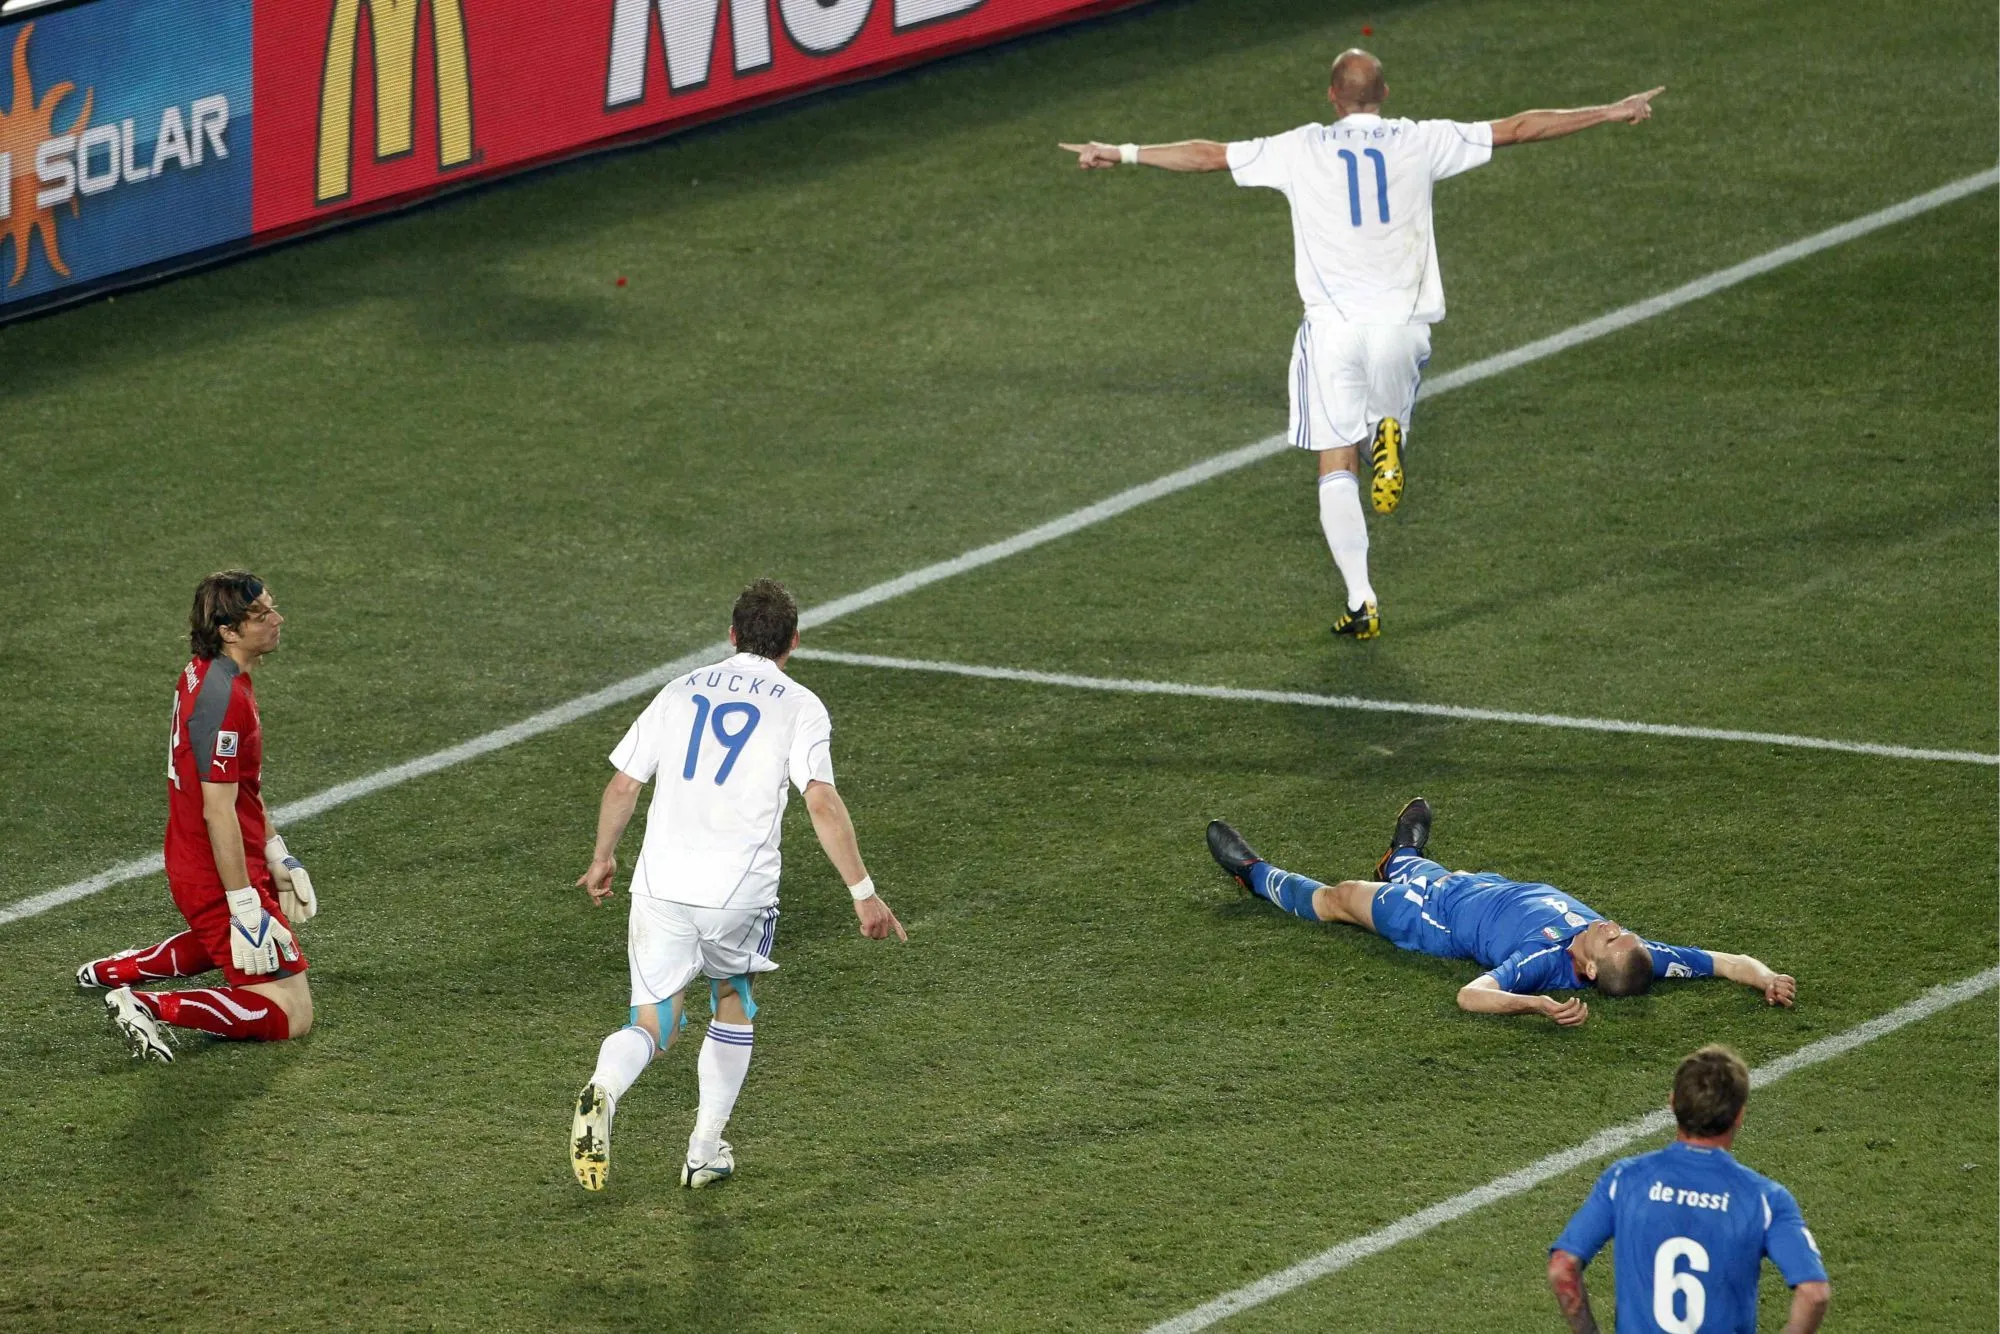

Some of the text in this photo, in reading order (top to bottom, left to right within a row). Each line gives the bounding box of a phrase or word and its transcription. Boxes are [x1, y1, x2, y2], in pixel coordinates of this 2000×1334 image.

[35, 94, 230, 210] SOLAR
[1337, 148, 1391, 228] 11
[685, 671, 787, 699] KUCKA
[683, 693, 761, 787] 19
[1648, 1181, 1731, 1213] de rossi
[1653, 1236, 1710, 1334] 6
